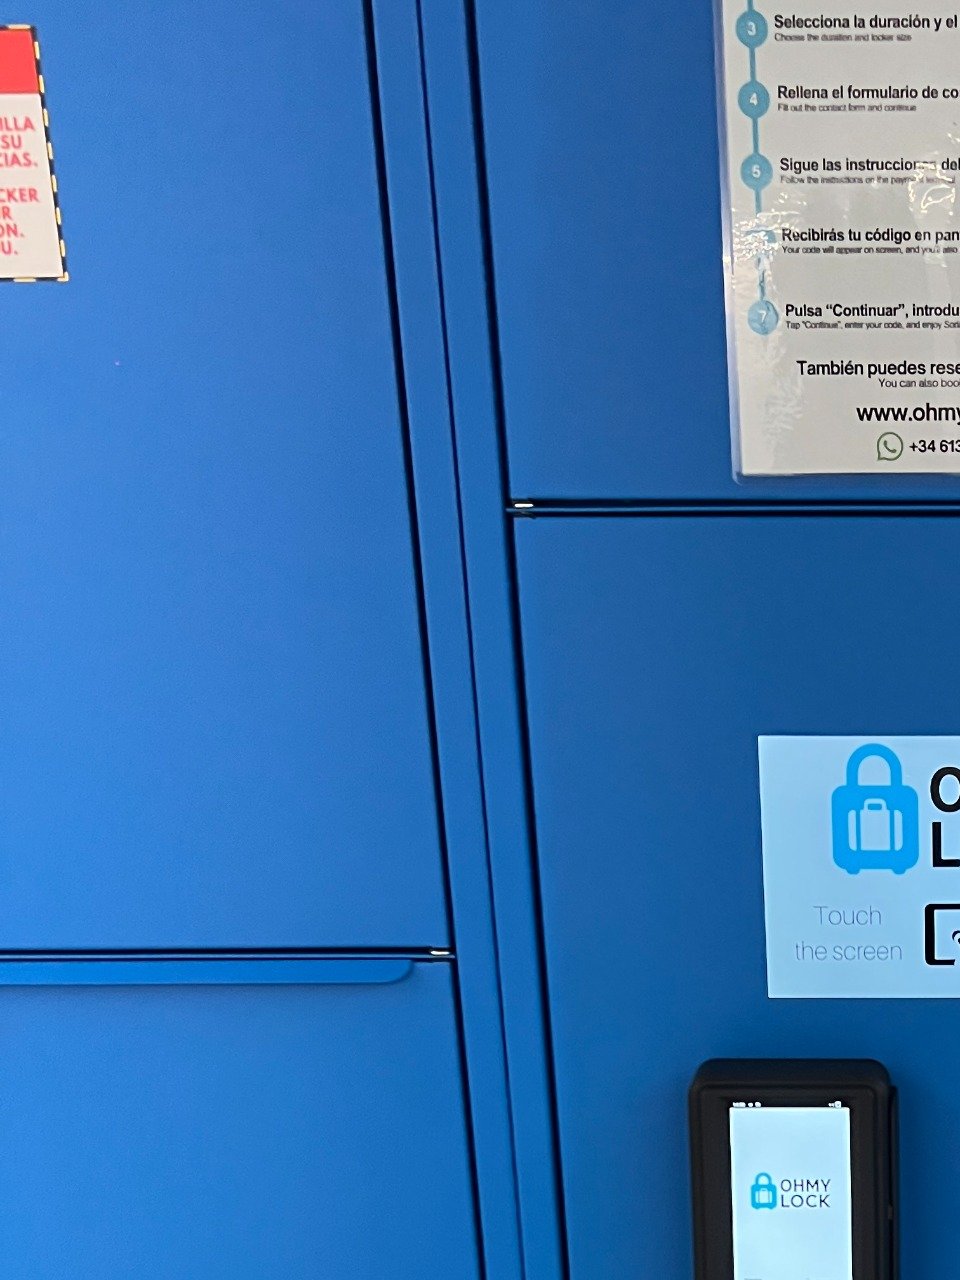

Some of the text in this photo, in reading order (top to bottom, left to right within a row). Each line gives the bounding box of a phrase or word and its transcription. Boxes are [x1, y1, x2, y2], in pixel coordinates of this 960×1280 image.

[748, 22, 756, 35] 3
[774, 14, 850, 28] Selecciona
[854, 14, 865, 28] la
[869, 14, 930, 28] duración
[934, 17, 942, 32] y
[946, 14, 958, 28] el
[777, 85, 828, 99] Rellena
[832, 85, 843, 99] el
[848, 85, 918, 99] formulario
[922, 85, 938, 99] de
[750, 93, 758, 106] 4
[752, 165, 760, 178] 5
[780, 158, 819, 174] Sigue
[822, 158, 842, 171] las
[846, 157, 936, 171] instruccion
[941, 158, 960, 171] del
[782, 228, 845, 241] Recibirás
[849, 228, 861, 241] tu
[865, 228, 911, 244] código
[915, 231, 931, 241] en
[758, 310, 766, 322] 7
[785, 304, 822, 317] Pulsa
[796, 360, 863, 376] También
[867, 360, 926, 378] puedes
[878, 378, 897, 388] You
[900, 378, 916, 388] can
[919, 378, 938, 388] also
[909, 440, 936, 452] +34
[813, 905, 882, 926] Touch
[795, 941, 903, 962] the screen
[780, 1179, 831, 1193] OHMY
[780, 1194, 831, 1208] LOCK
